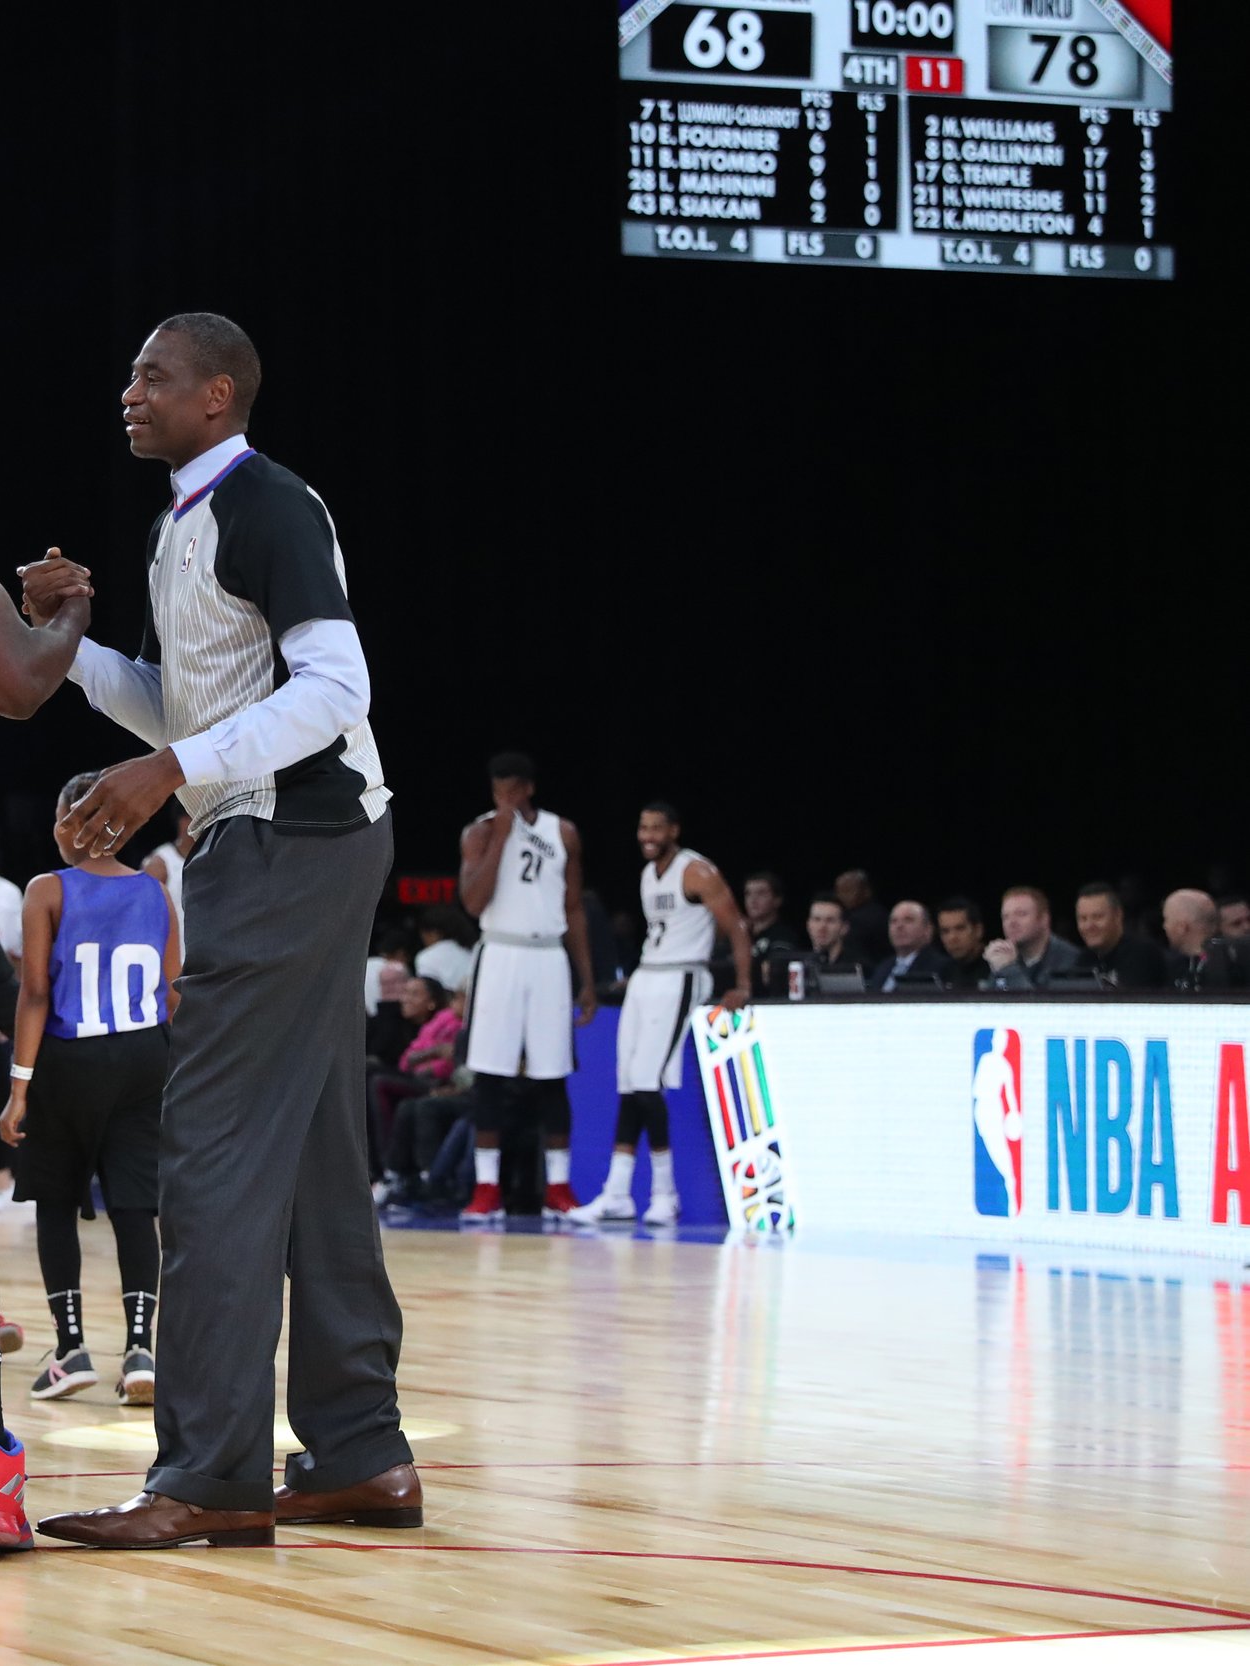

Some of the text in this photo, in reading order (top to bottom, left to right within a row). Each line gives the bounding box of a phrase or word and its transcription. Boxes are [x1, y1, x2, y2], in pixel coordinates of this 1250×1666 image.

[855, 0, 953, 39] 10:00
[683, 9, 765, 71] 68
[844, 55, 950, 88] 4TH 11
[1029, 34, 1099, 87] 78
[640, 99, 656, 121] 7
[804, 108, 832, 131] 13
[866, 112, 878, 133] 1
[801, 91, 833, 109] PTS
[1079, 106, 1110, 124] PTS
[629, 121, 657, 145] 10
[808, 132, 826, 154] 6
[865, 134, 877, 156] 1
[924, 114, 941, 137] 2
[1086, 124, 1103, 145] 9
[1141, 127, 1153, 148] 1
[629, 145, 654, 167] 11
[808, 155, 826, 176] 9
[865, 157, 877, 180] 1
[1082, 147, 1108, 168] 17
[1139, 150, 1156, 171] 3
[628, 168, 657, 192] 28
[808, 178, 826, 201] 6
[863, 180, 881, 203] 0
[914, 160, 941, 182] 17
[1083, 170, 1107, 191] 11
[1140, 172, 1156, 194] 2
[627, 192, 657, 215] 43
[809, 201, 827, 223] 2
[863, 203, 881, 227] 0
[913, 183, 939, 206] 21
[1083, 192, 1107, 214] 11
[1140, 194, 1156, 216] 2
[913, 206, 941, 229] 22
[1087, 215, 1103, 237] 4
[1141, 217, 1153, 239] 1
[730, 228, 748, 252] 4
[787, 231, 874, 259] FLS 0
[1013, 242, 1031, 266] 4
[1069, 245, 1153, 272] FLS 0
[520, 850, 543, 882] 21
[399, 877, 455, 904] EXIT
[75, 942, 161, 1038] 10
[1046, 1038, 1250, 1225] NBA A
